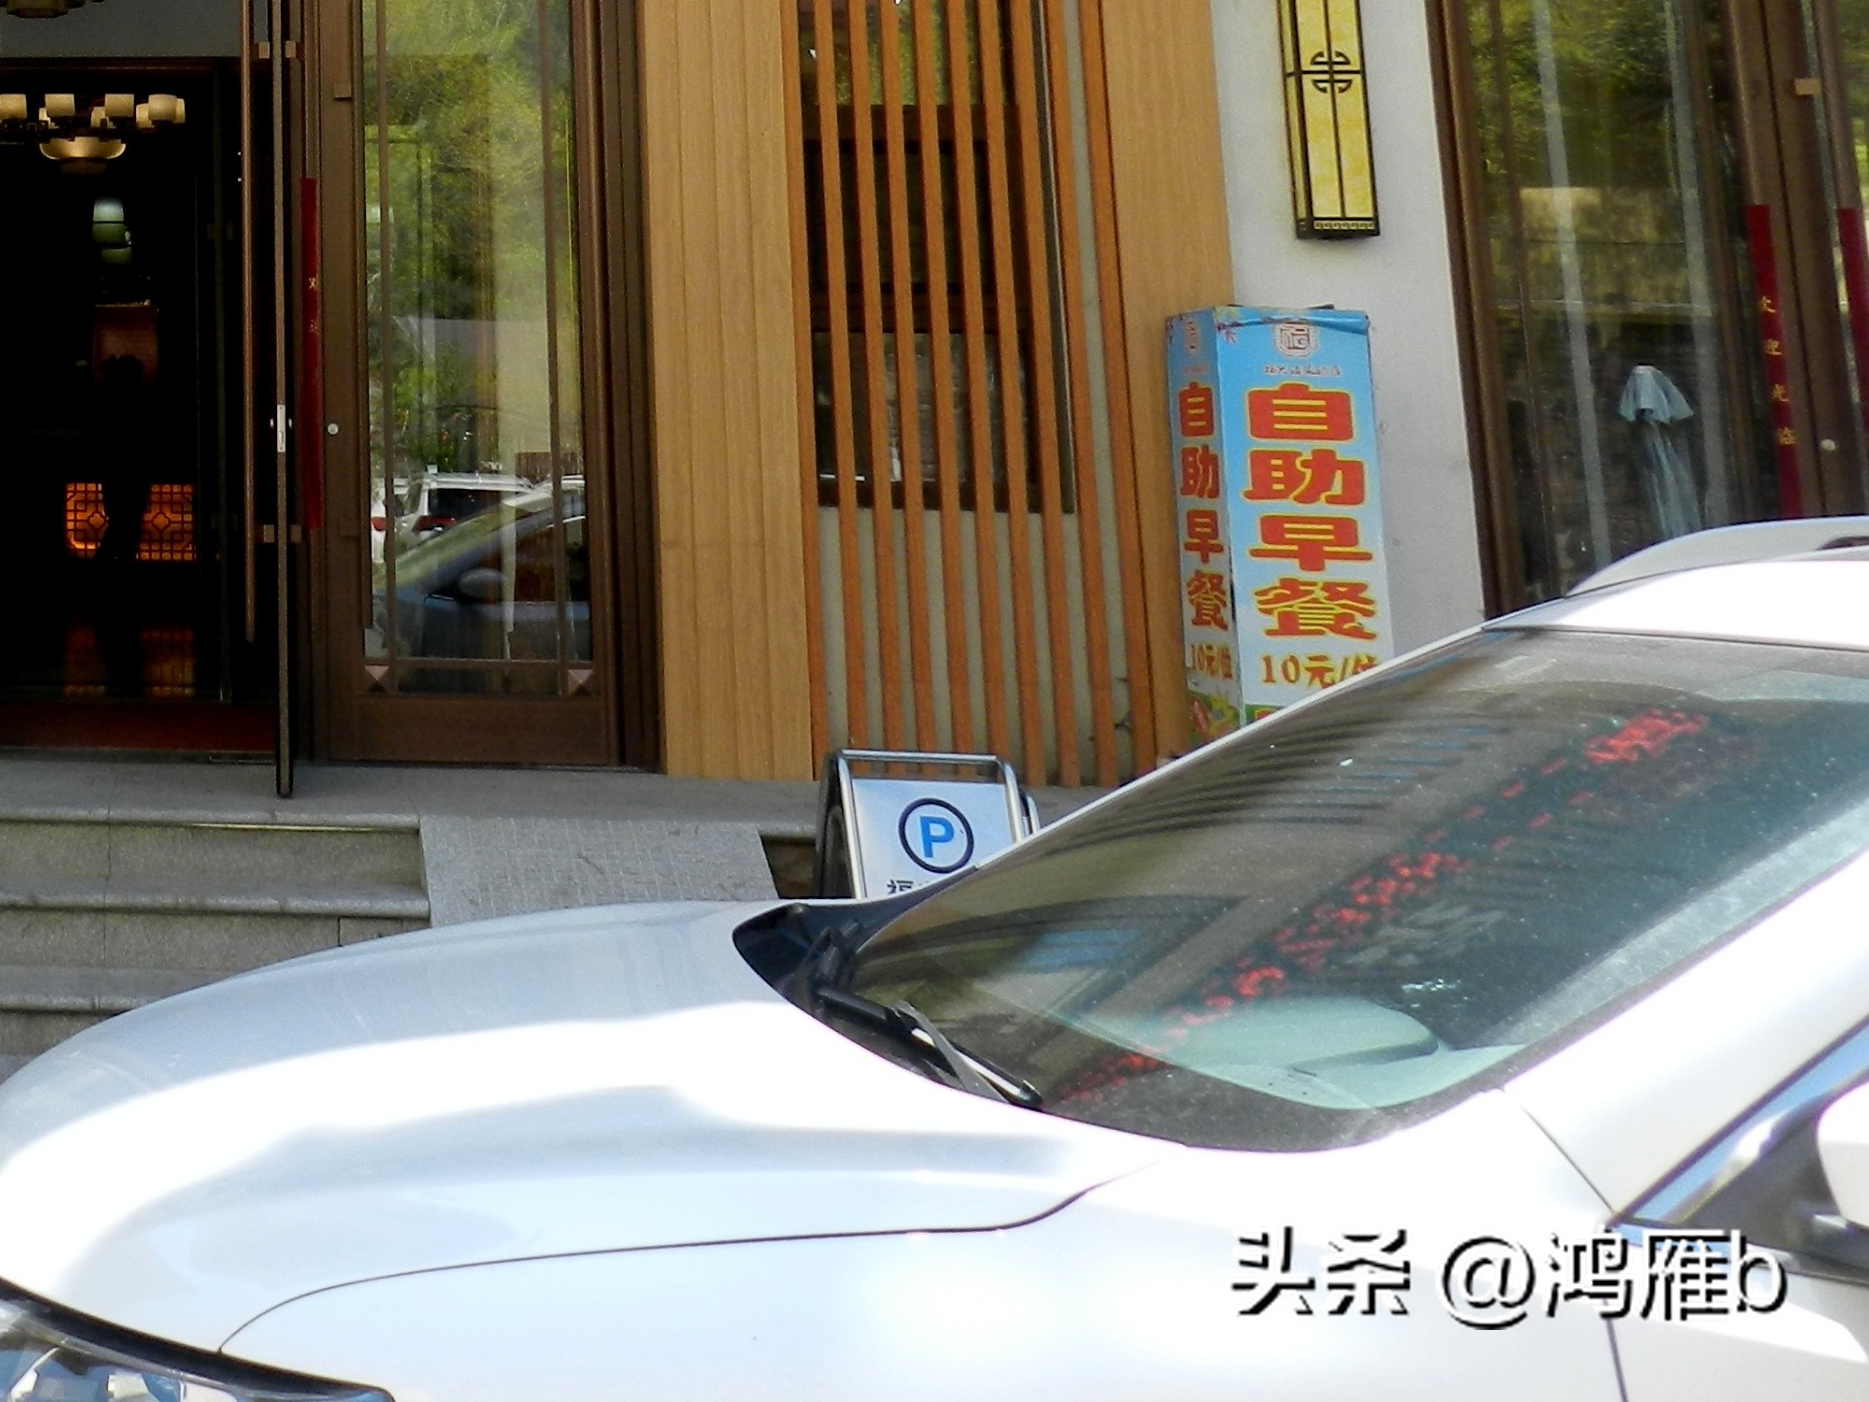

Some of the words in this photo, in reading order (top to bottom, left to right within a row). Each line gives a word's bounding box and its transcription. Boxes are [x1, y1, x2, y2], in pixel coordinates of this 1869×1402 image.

[1178, 382, 1229, 629] 自助早餐
[1243, 383, 1377, 640] 自助早餐
[919, 816, 955, 858] P
